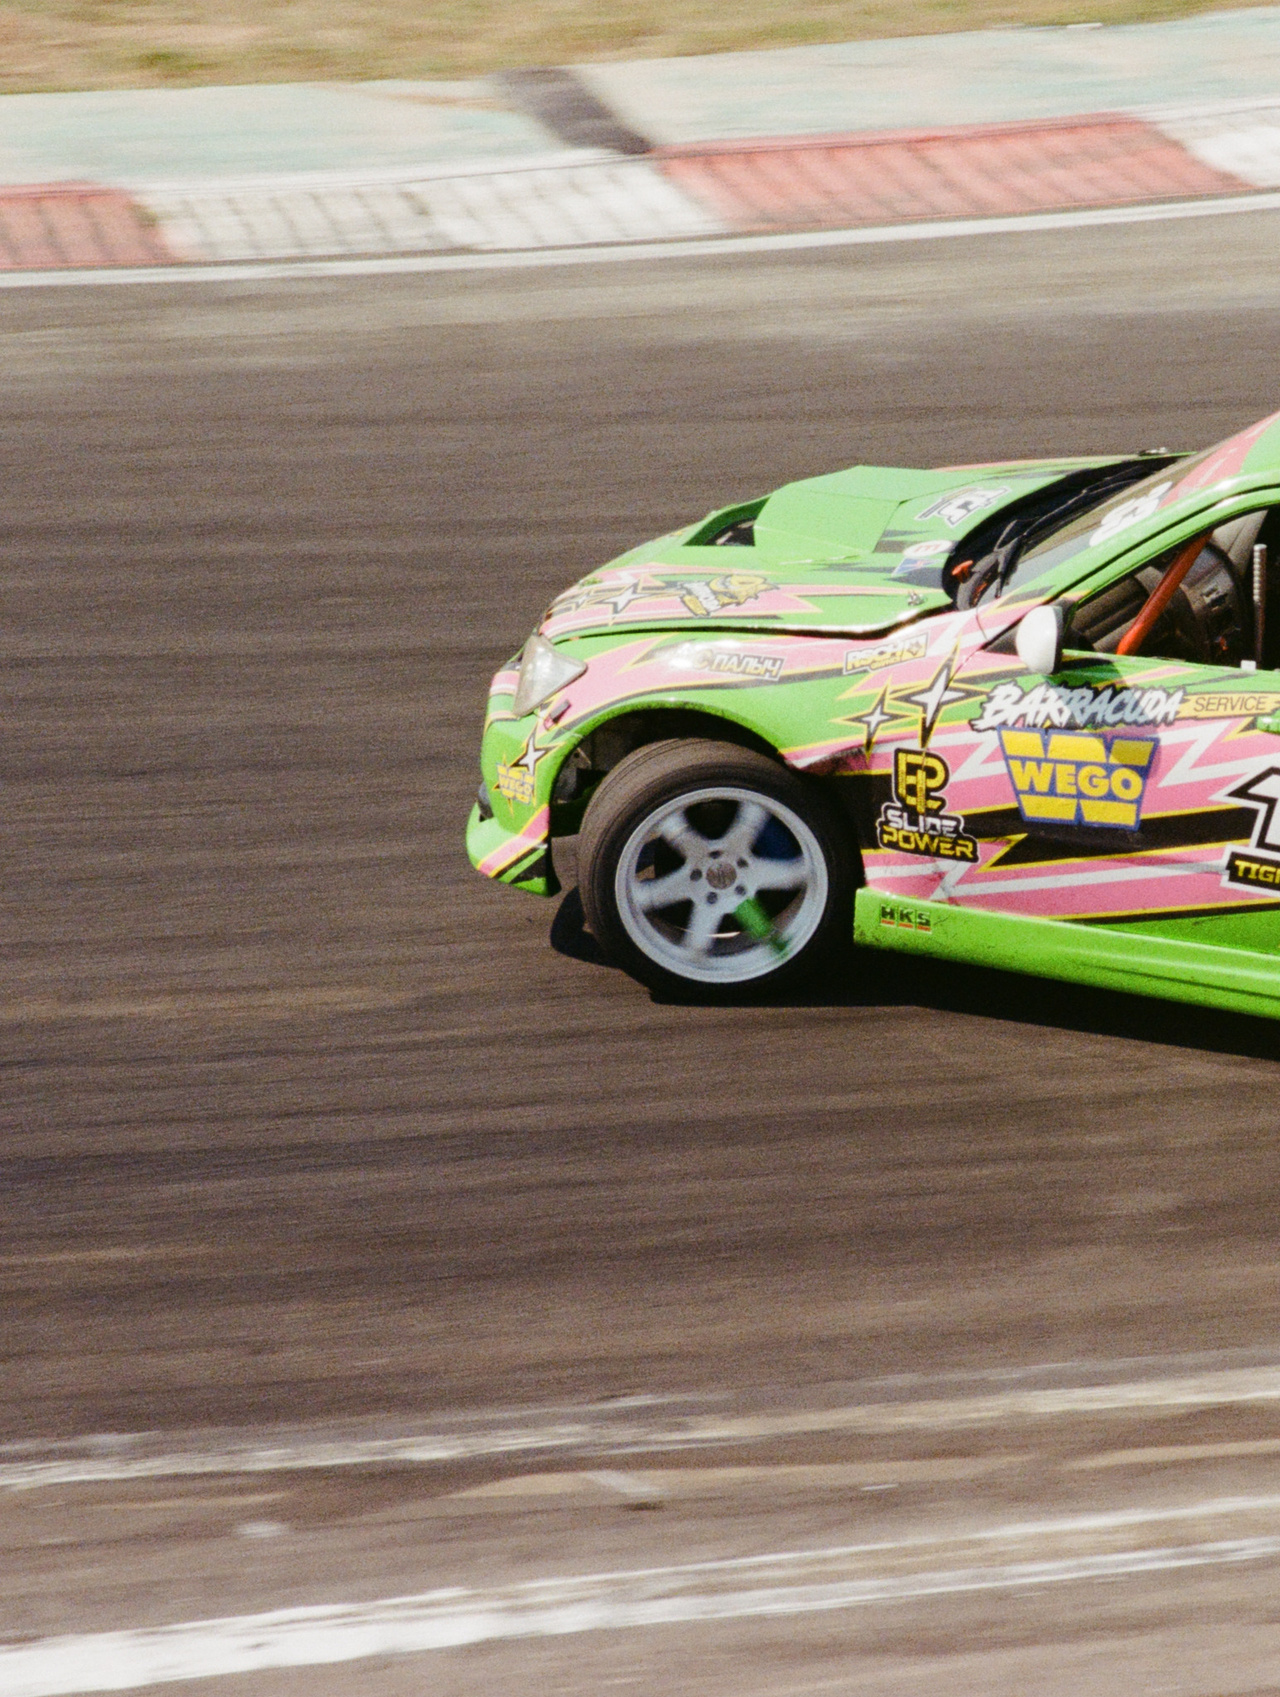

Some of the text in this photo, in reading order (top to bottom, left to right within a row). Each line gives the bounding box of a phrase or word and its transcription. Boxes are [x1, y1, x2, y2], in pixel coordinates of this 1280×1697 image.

[972, 682, 1267, 731] BARRACUDA SERVICE
[1008, 759, 1143, 800] WEGO
[886, 809, 957, 837] SLIDE
[882, 825, 974, 858] POWER
[881, 906, 931, 927] HKS
